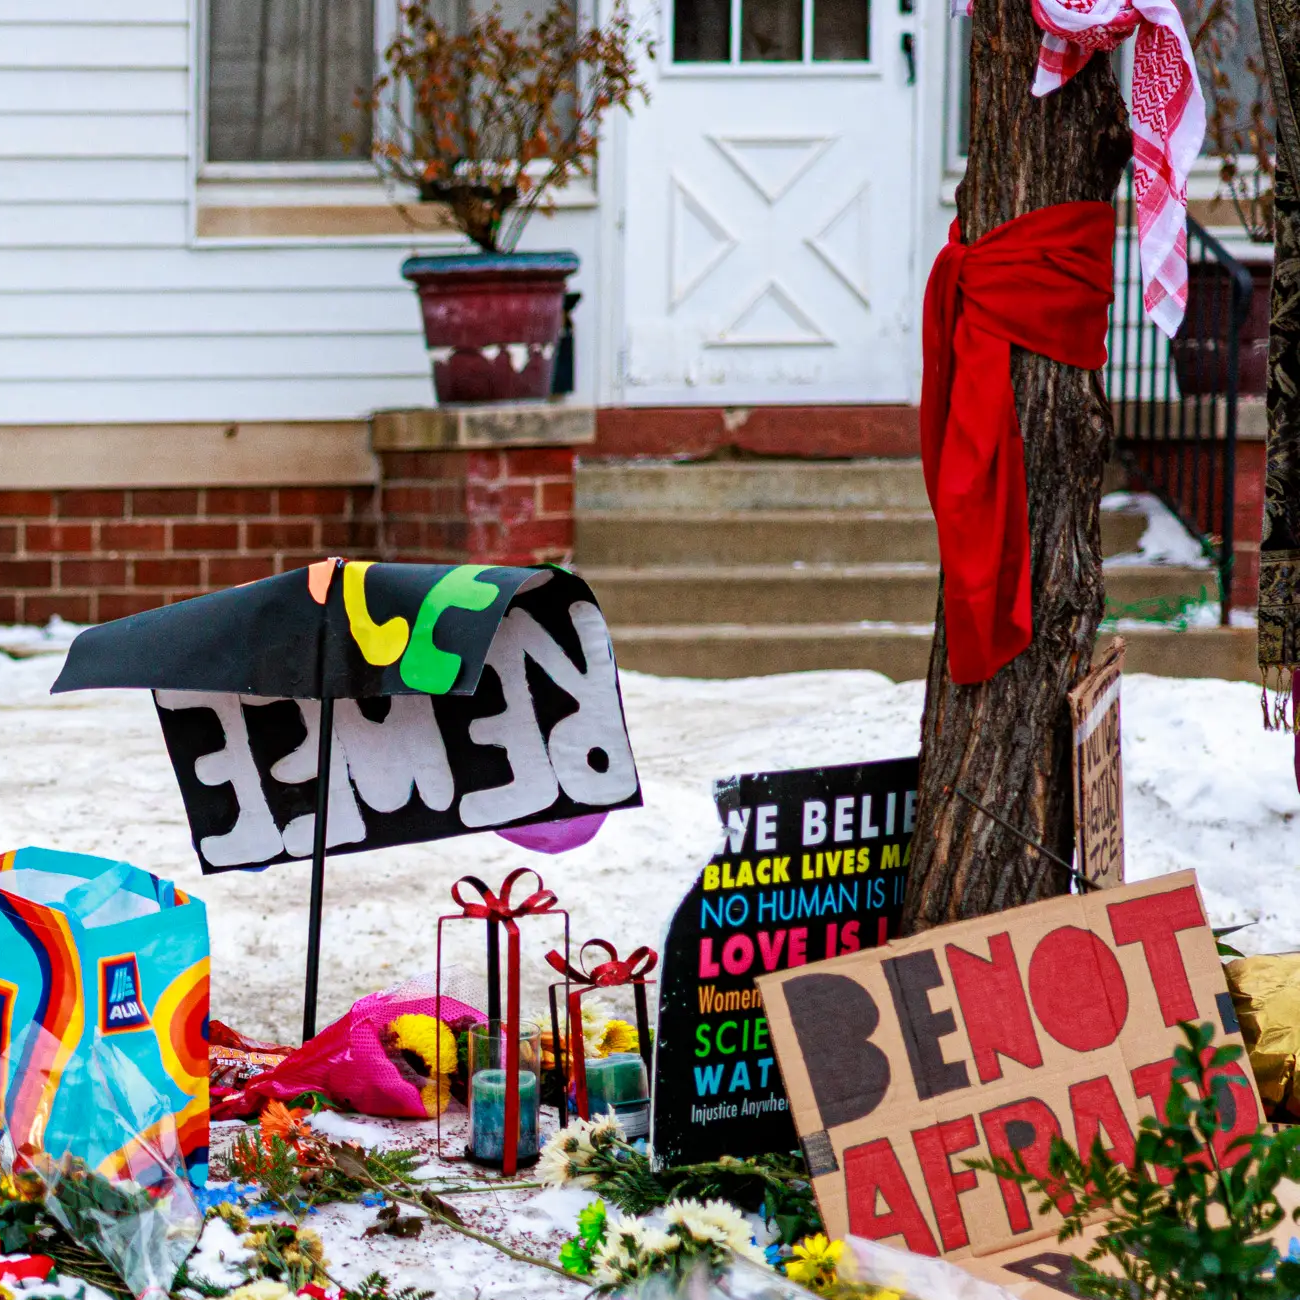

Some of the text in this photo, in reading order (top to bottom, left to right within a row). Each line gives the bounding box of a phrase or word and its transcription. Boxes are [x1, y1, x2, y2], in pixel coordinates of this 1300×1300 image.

[703, 856, 791, 891] BLACK
[802, 846, 870, 880] LIVES
[701, 894, 749, 929] NO
[758, 881, 858, 923] HUMAN
[866, 877, 886, 909] IS
[700, 926, 808, 979] LOVE
[825, 920, 861, 960] IS
[109, 1001, 142, 1021] ALDI
[699, 985, 762, 1014] Women
[782, 885, 1206, 1129] BE NOT
[695, 1017, 767, 1058] SCIE
[694, 1057, 774, 1097] WAT
[691, 1101, 738, 1126] Injustice
